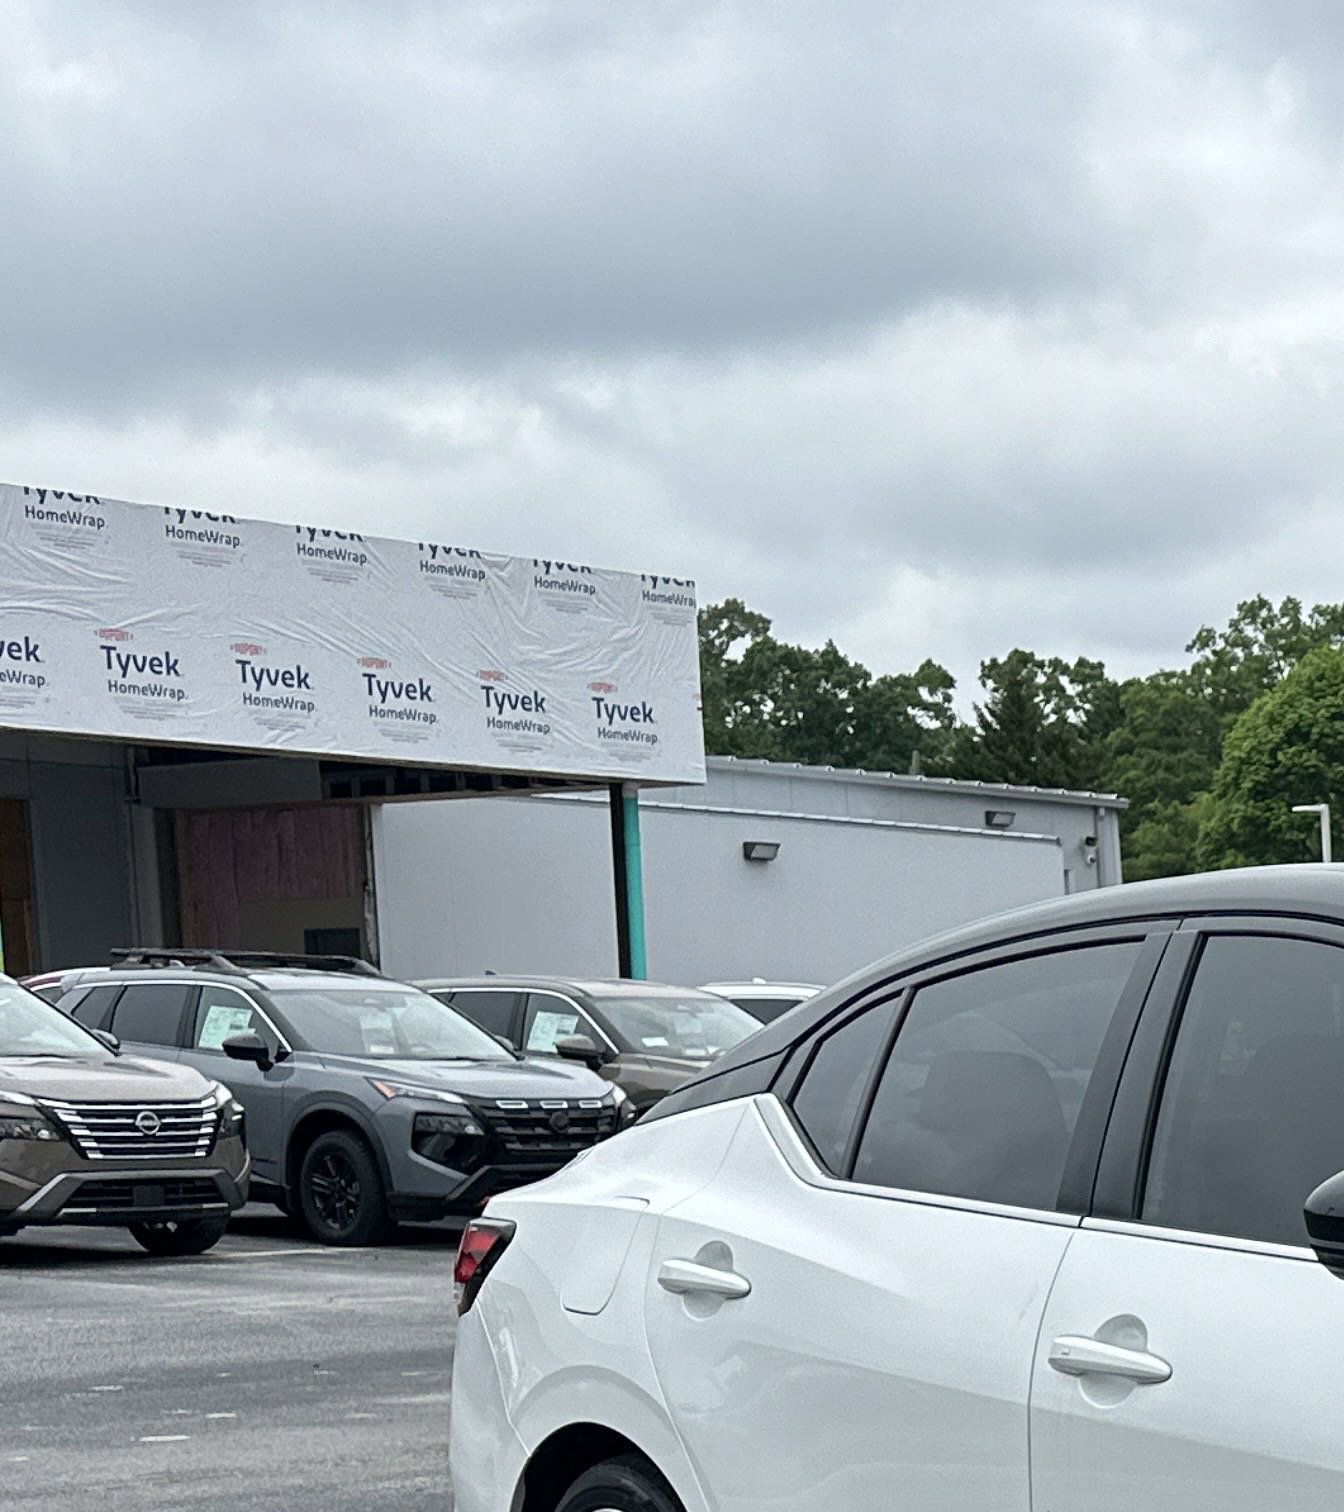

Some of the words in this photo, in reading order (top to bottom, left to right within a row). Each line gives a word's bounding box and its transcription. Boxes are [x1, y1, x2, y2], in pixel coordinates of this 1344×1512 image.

[24, 505, 105, 530] HomeWrap
[165, 525, 241, 549] HomeWrap
[296, 542, 368, 566] HomeWrap
[420, 560, 486, 581] HomeWrap
[534, 576, 596, 596] HomeWrap
[100, 645, 182, 678] Tyvek
[235, 659, 311, 692] Tyvek
[108, 679, 186, 701] HomeWrap
[362, 673, 433, 704] Tyvek
[480, 685, 547, 715] Tyvek
[243, 692, 315, 713] HomeWrap
[592, 697, 655, 726] Tyvek
[369, 705, 437, 725] HomeWrap
[487, 717, 551, 735] HomeWrap
[598, 728, 659, 745] HomeWrap
